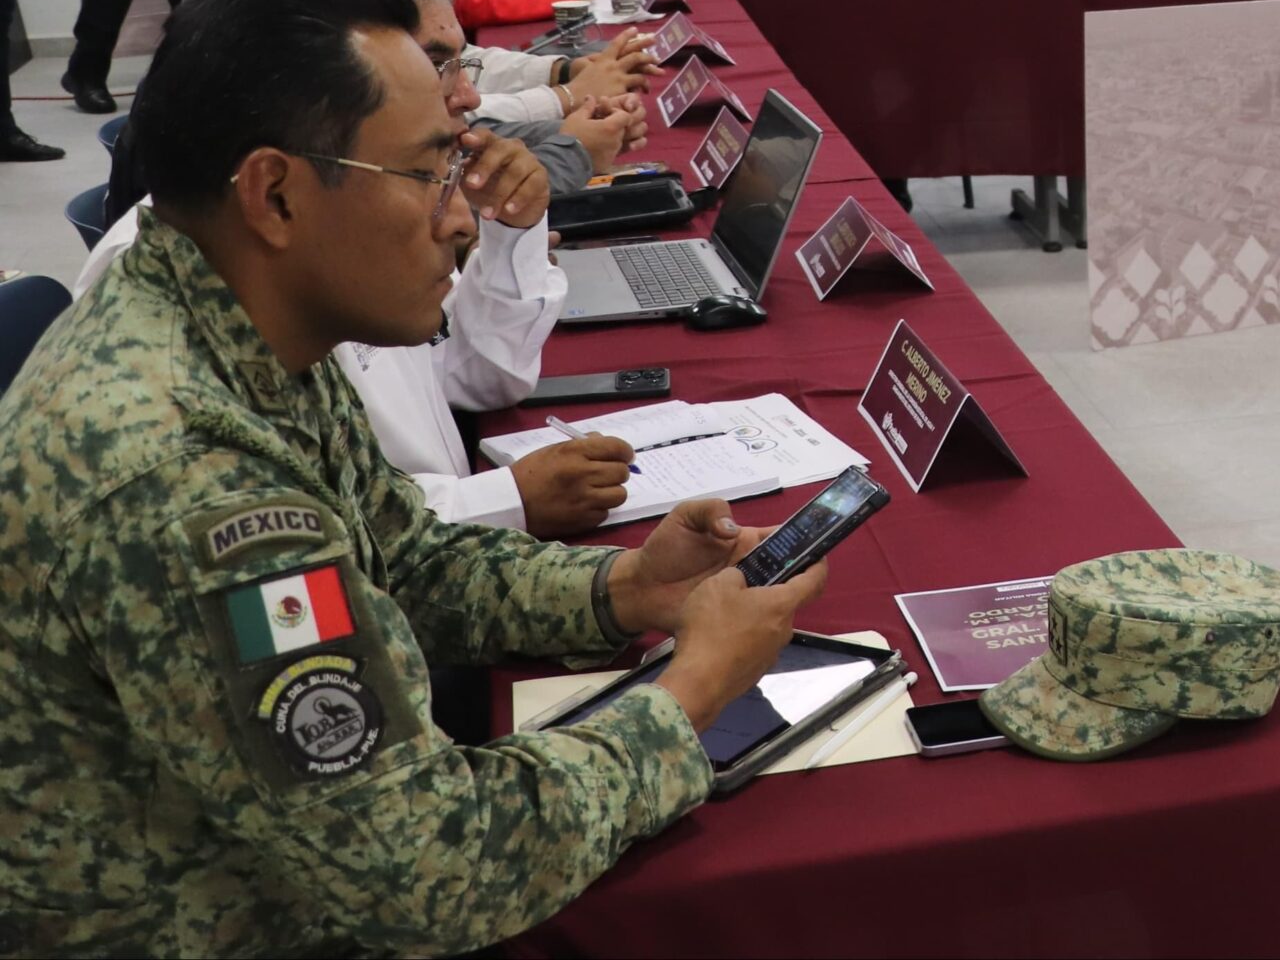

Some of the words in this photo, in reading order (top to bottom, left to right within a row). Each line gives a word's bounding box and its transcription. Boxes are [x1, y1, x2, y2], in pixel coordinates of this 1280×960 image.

[905, 347, 930, 380] ALBERTO
[925, 371, 951, 404] JIMÉNEZ
[213, 510, 321, 553] MEXICO
[972, 623, 1041, 639] GRAL.
[287, 683, 307, 700] DEL
[309, 673, 362, 693] BLINDAJE
